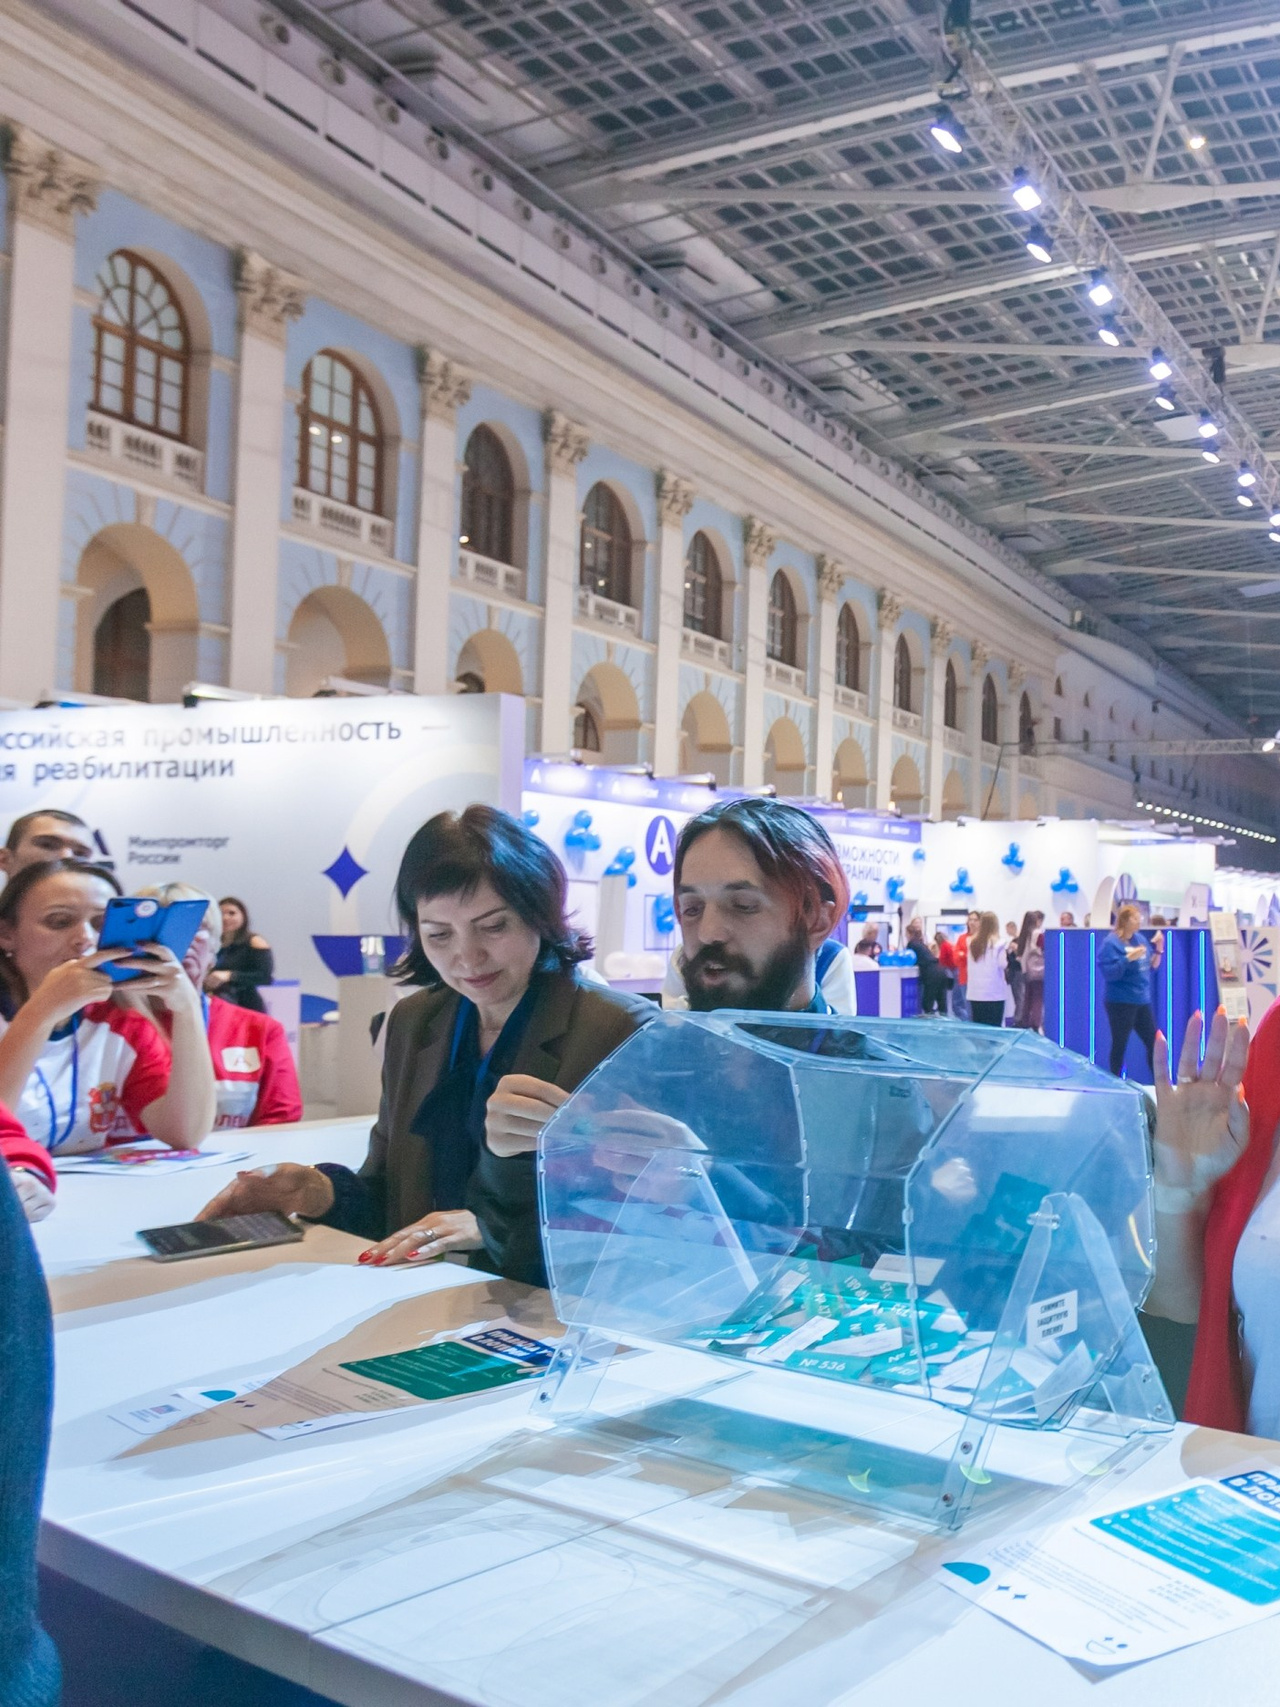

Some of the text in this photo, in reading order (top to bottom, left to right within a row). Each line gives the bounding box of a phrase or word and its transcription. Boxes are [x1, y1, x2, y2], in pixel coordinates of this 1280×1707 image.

[0, 724, 125, 750] ссийская
[144, 721, 403, 752] промышленность
[33, 756, 235, 787] реабилитации
[128, 852, 181, 864] России
[818, 1360, 846, 1371] 536
